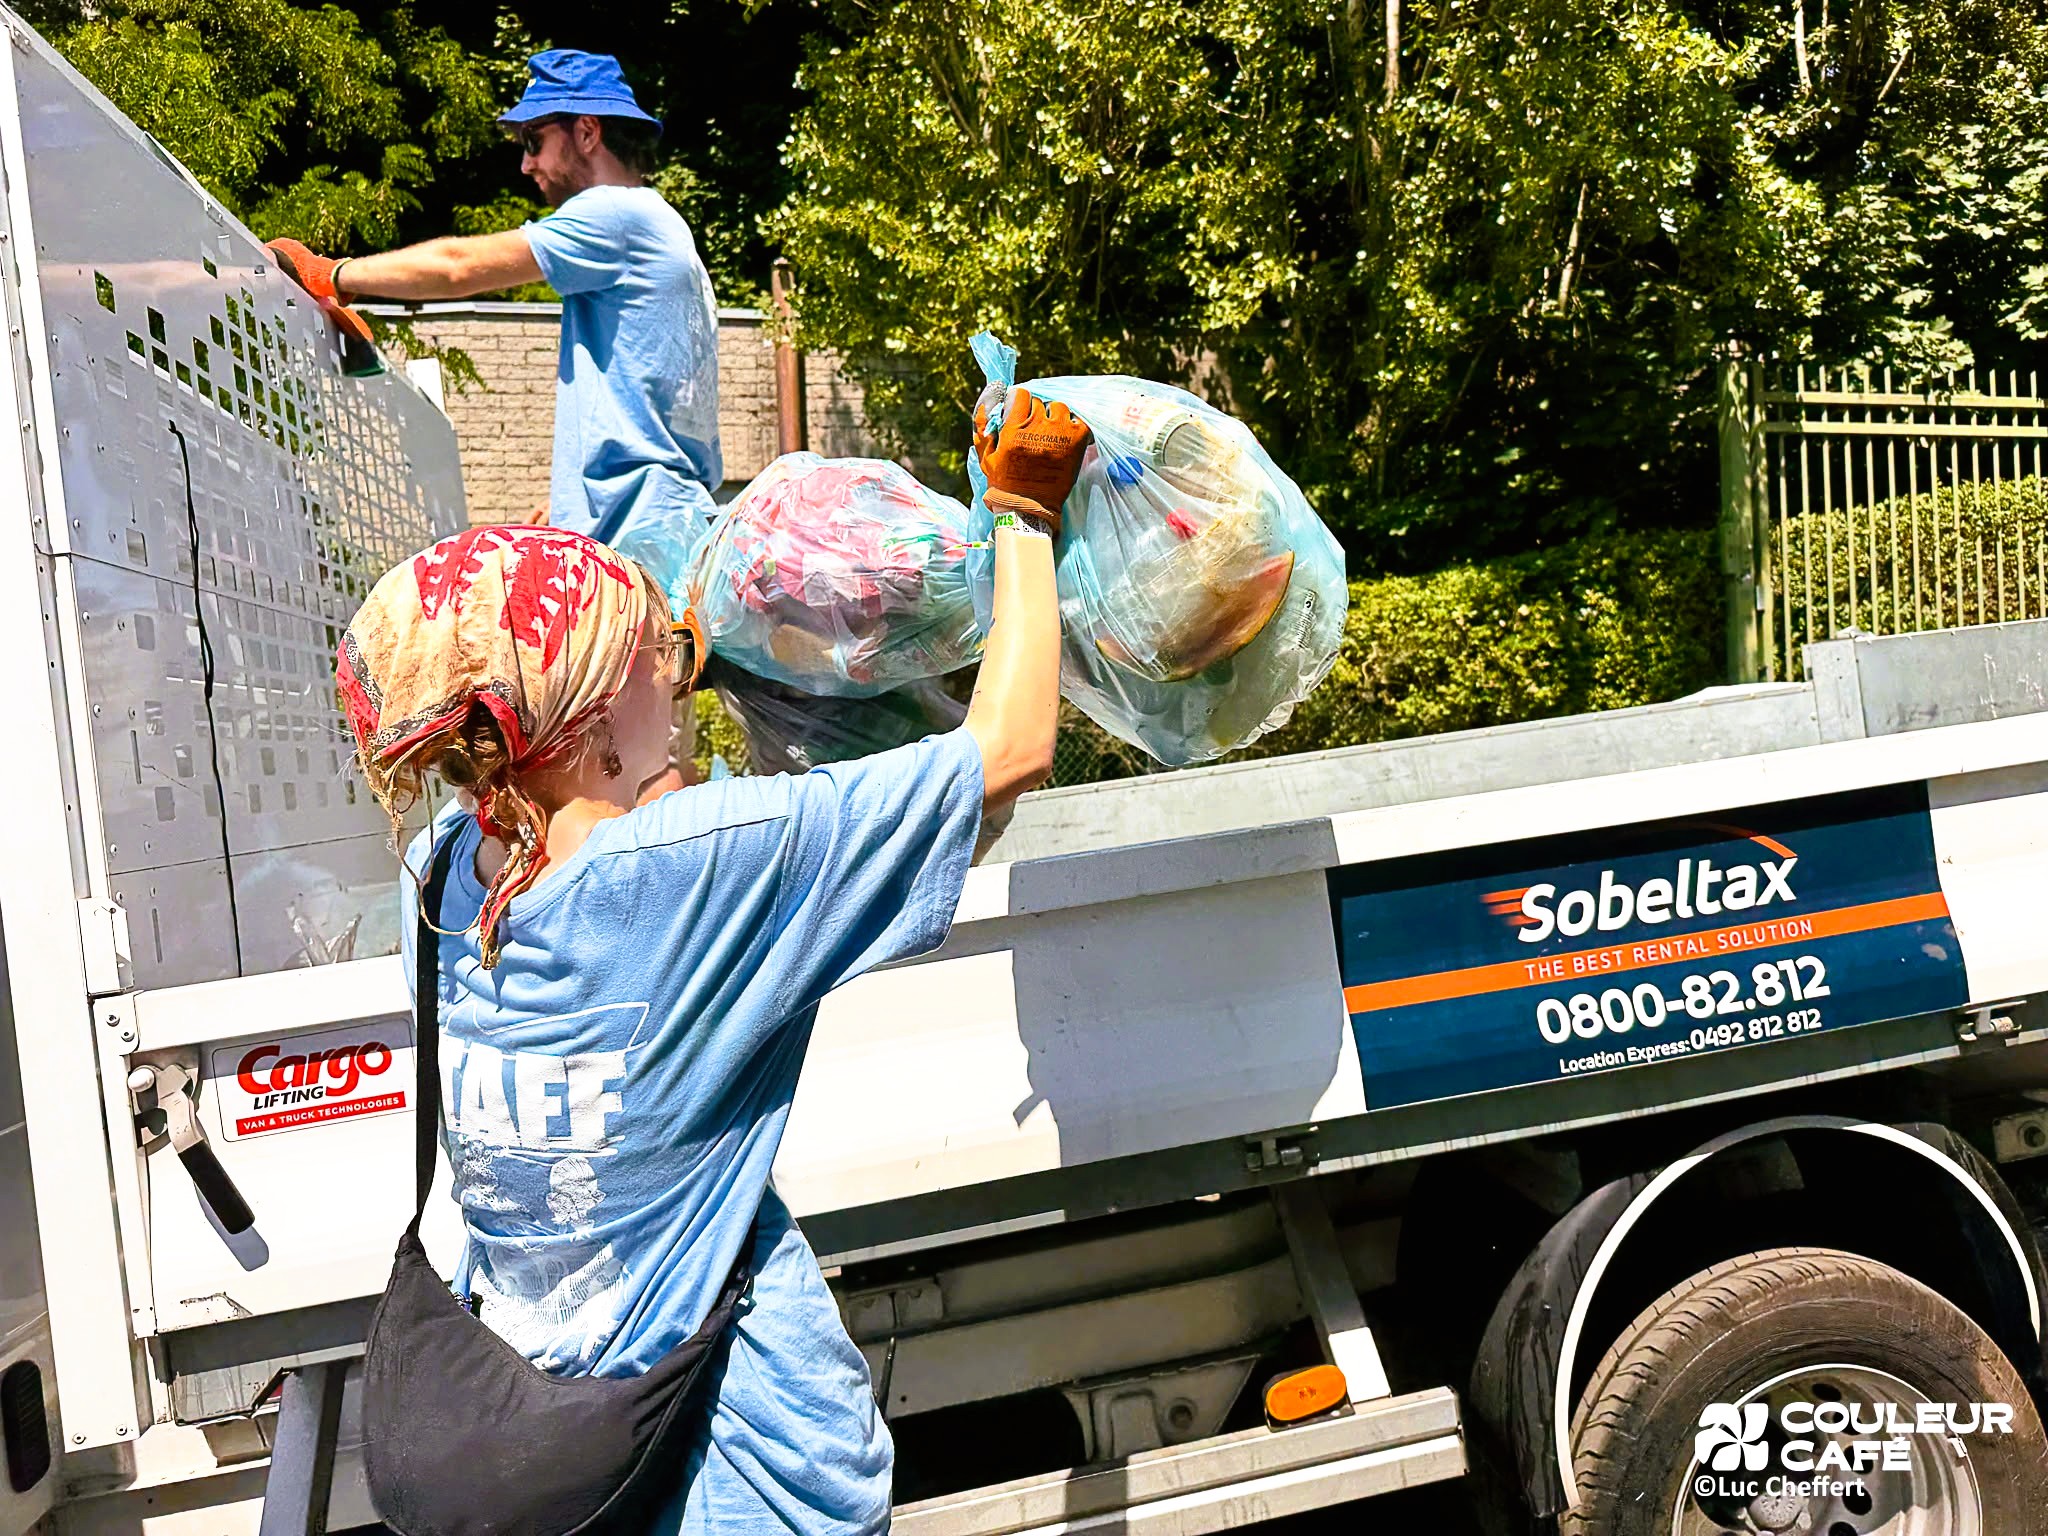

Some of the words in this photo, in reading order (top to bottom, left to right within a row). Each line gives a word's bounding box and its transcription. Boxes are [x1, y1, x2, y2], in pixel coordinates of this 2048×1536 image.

[1517, 857, 1798, 943] Sobeltax
[1524, 960, 1565, 980] THE
[1572, 949, 1623, 973] BEST
[1633, 937, 1710, 963] RENTAL
[1717, 919, 1814, 949] SOLUTION
[1536, 955, 1831, 1044] 0800-82.812
[236, 1041, 392, 1097] Cargo
[1559, 1050, 1625, 1074] Location
[1690, 1022, 1746, 1051] 0492
[1748, 1015, 1783, 1041] 812
[1787, 1008, 1823, 1033] 812
[243, 1119, 266, 1130] VAN
[268, 1117, 277, 1126] &
[279, 1111, 315, 1124] TRUCK
[318, 1096, 400, 1117] TECHNOLOGIES
[253, 1086, 324, 1110] LIFTING
[438, 1034, 627, 1151] TAFF
